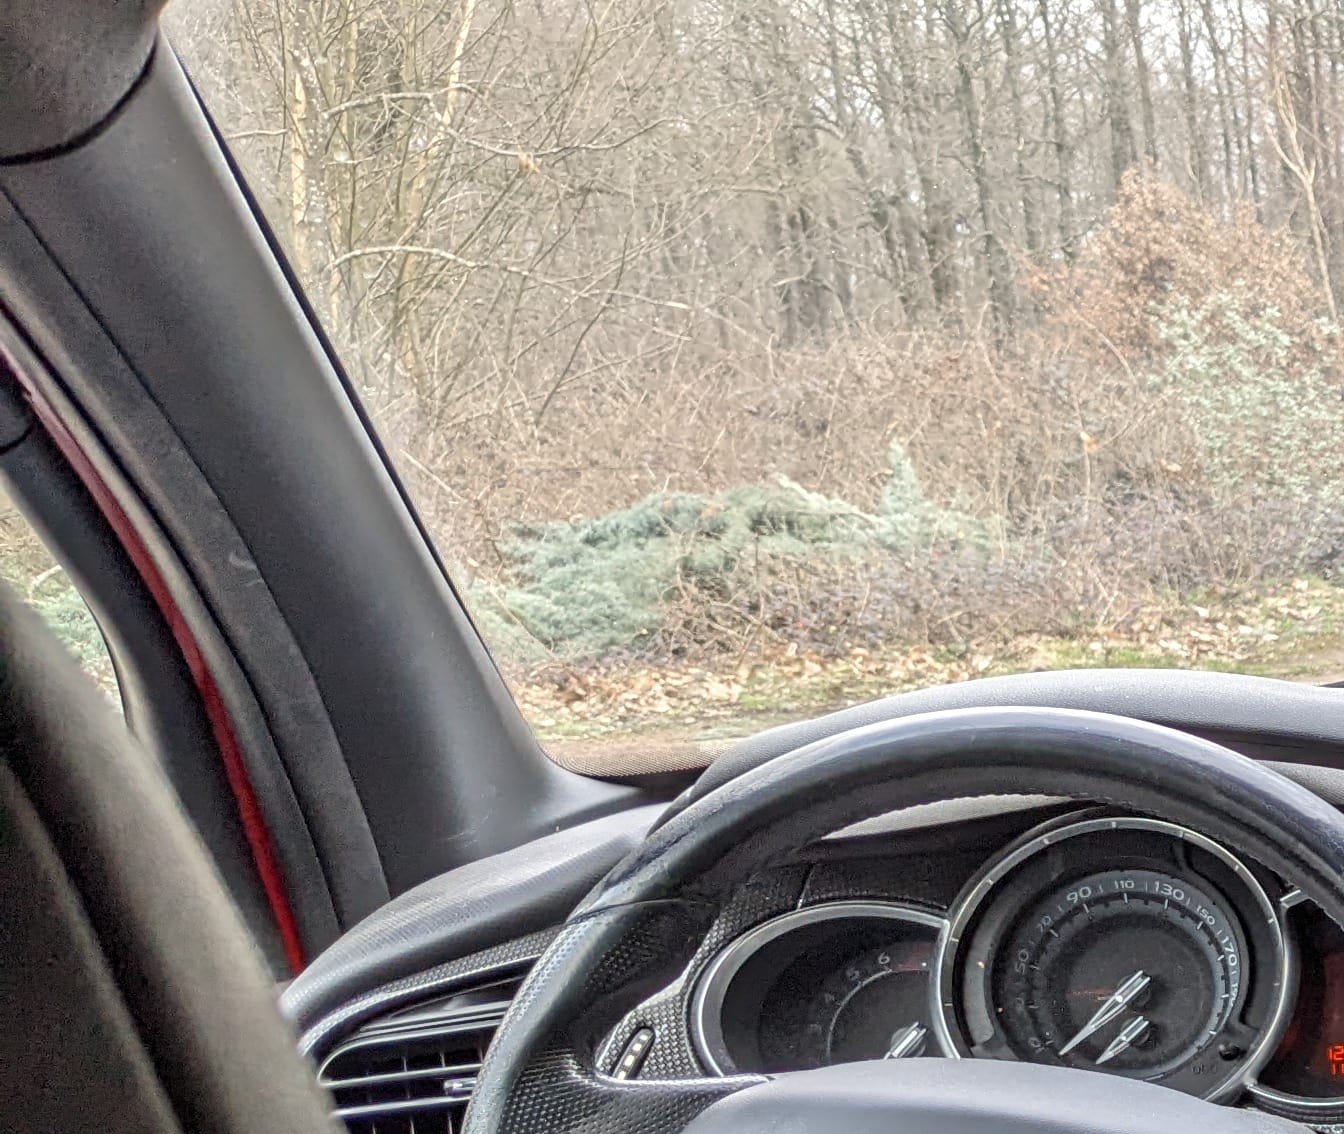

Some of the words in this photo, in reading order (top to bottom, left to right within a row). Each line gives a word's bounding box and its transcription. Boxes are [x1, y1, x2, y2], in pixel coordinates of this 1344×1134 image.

[1114, 880, 1135, 890] 110
[1153, 880, 1185, 901] 130
[1066, 886, 1092, 904] 90
[1196, 904, 1216, 926] 150
[878, 952, 891, 965] 6
[1220, 935, 1239, 967] 170
